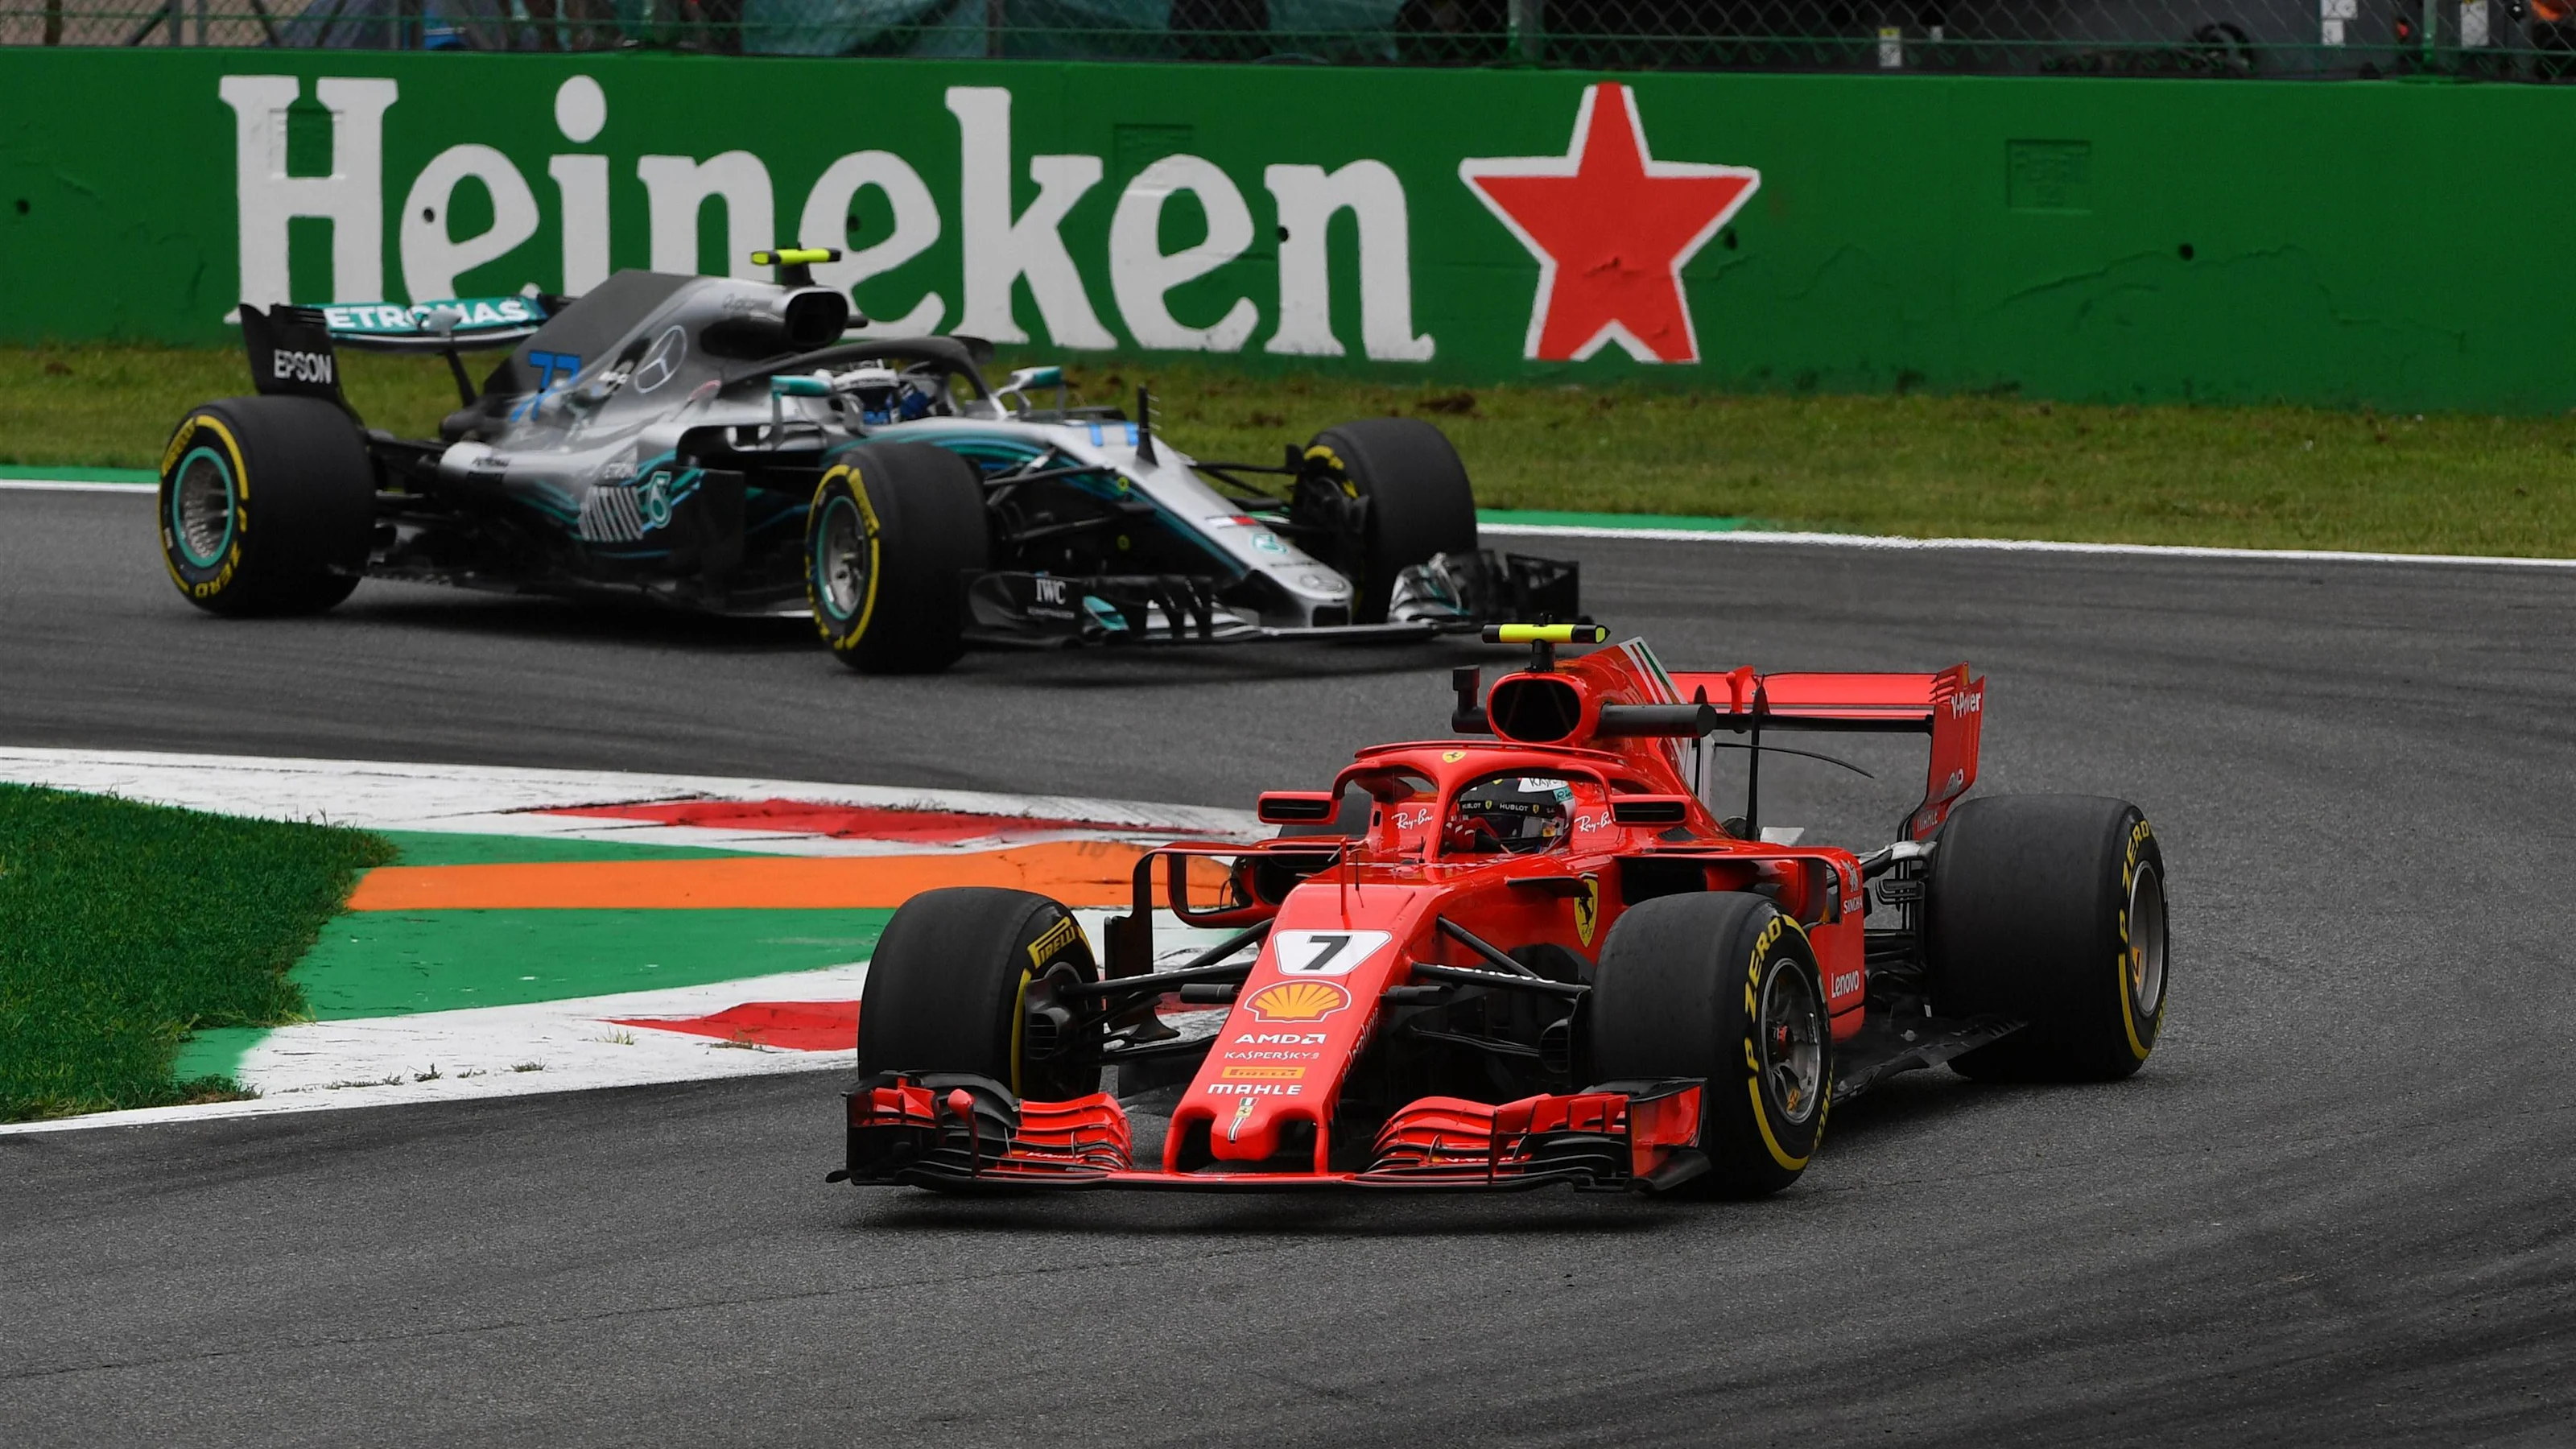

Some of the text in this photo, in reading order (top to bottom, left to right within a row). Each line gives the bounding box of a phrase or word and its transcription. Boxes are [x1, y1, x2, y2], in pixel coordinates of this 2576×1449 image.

[218, 76, 1435, 362] Heineken
[324, 299, 530, 328] ETROAS
[274, 349, 332, 384] EPSON
[1035, 578, 1066, 605] IWC
[1499, 802, 1529, 812] HUBLOT
[1573, 810, 1616, 833] Ray-Ba
[2122, 819, 2150, 899] ZERO
[1027, 916, 1076, 970] PIRELLI
[1300, 934, 1353, 972] 7
[1744, 914, 1782, 1074] P ZERO
[1831, 968, 1860, 999] Lenovo
[1234, 1033, 1307, 1045] AMD
[1224, 1049, 1313, 1061] KASPERSKY
[1207, 1083, 1303, 1096] MAHLE
